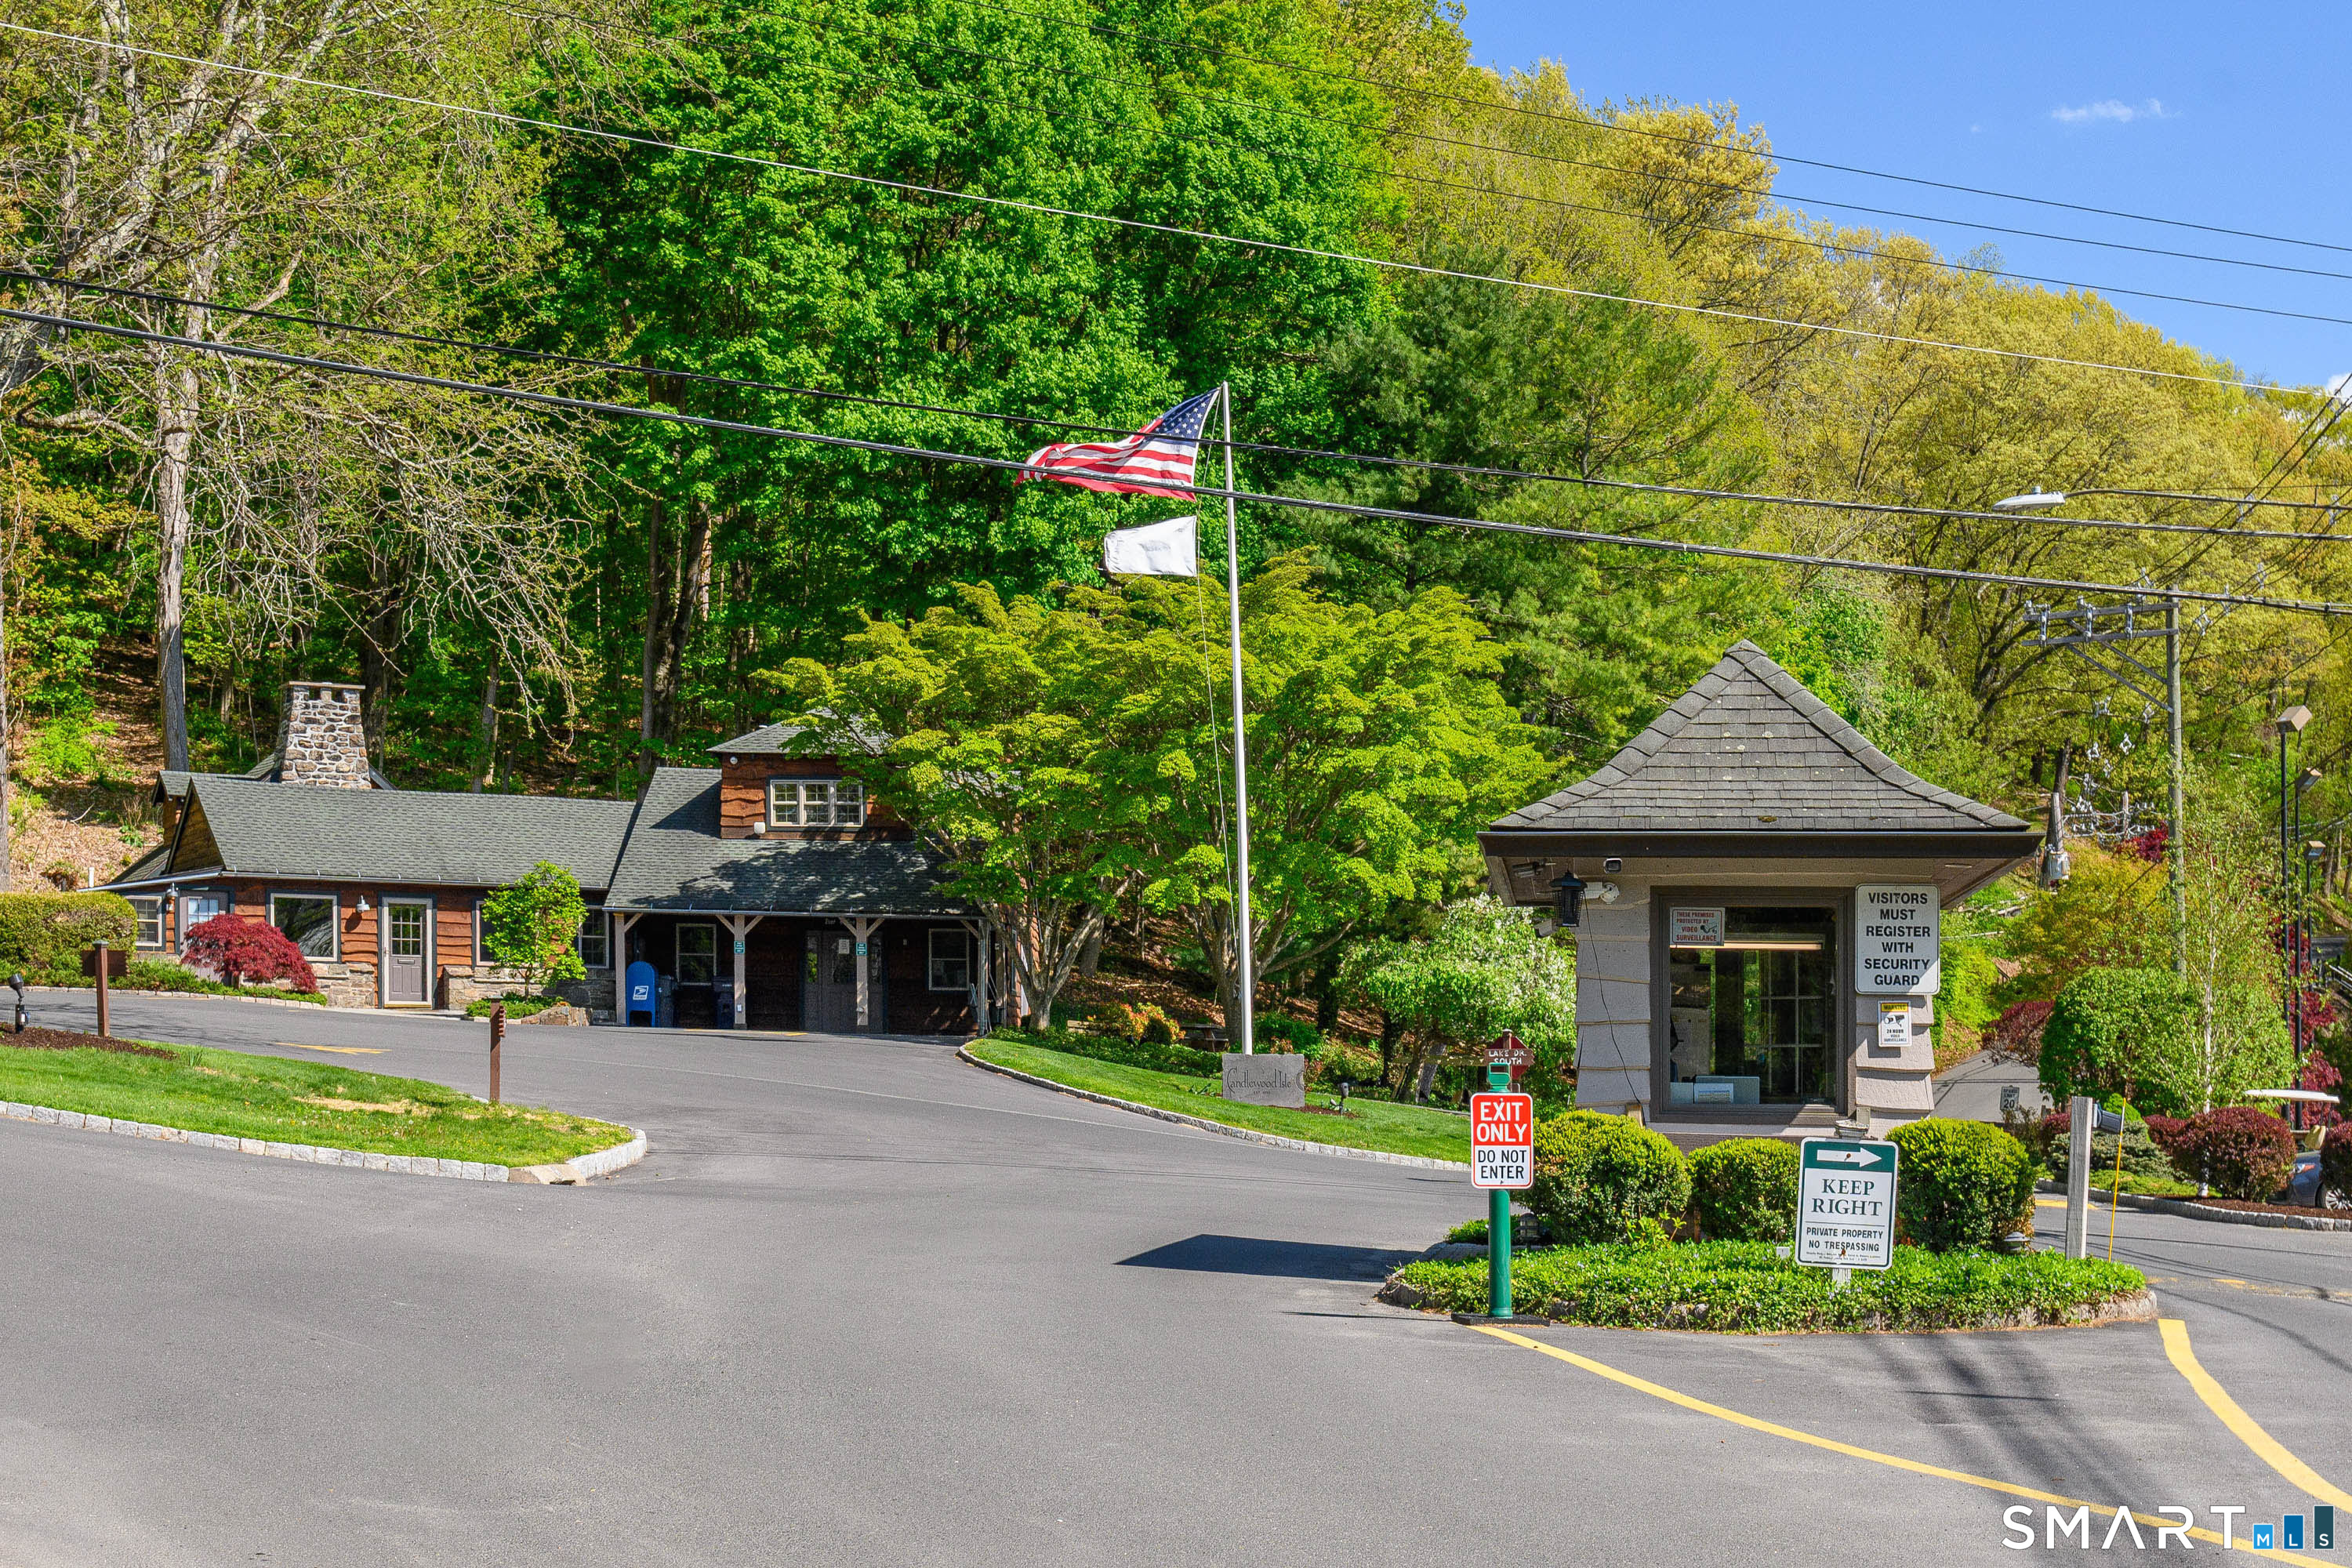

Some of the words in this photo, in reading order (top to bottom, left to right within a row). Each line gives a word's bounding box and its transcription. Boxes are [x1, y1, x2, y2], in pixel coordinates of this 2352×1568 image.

[1868, 892, 1928, 904] VISITORS
[1880, 909, 1916, 920] MUST
[1866, 926, 1930, 937] REGISTER
[1882, 942, 1914, 953] WITH
[1864, 958, 1930, 970] SECURITY
[1875, 975, 1920, 985] GUARD
[1226, 1067, 1277, 1094] Candlewood
[1278, 1069, 1292, 1088] Isle
[2004, 1099, 2015, 1109] 20
[1480, 1102, 1523, 1121] EXIT
[1476, 1123, 1528, 1142] ONLY
[1478, 1150, 1496, 1163] DO
[1501, 1150, 1527, 1163] NOT
[1481, 1165, 1524, 1179] ENTER
[1821, 1178, 1875, 1196] KEEP
[1810, 1197, 1883, 1217] RIGHT
[1806, 1226, 1838, 1237] PRIVATE
[1841, 1229, 1884, 1240] PROPERTY
[1809, 1240, 1820, 1249] NO
[1824, 1241, 1880, 1252] TRESPASSING
